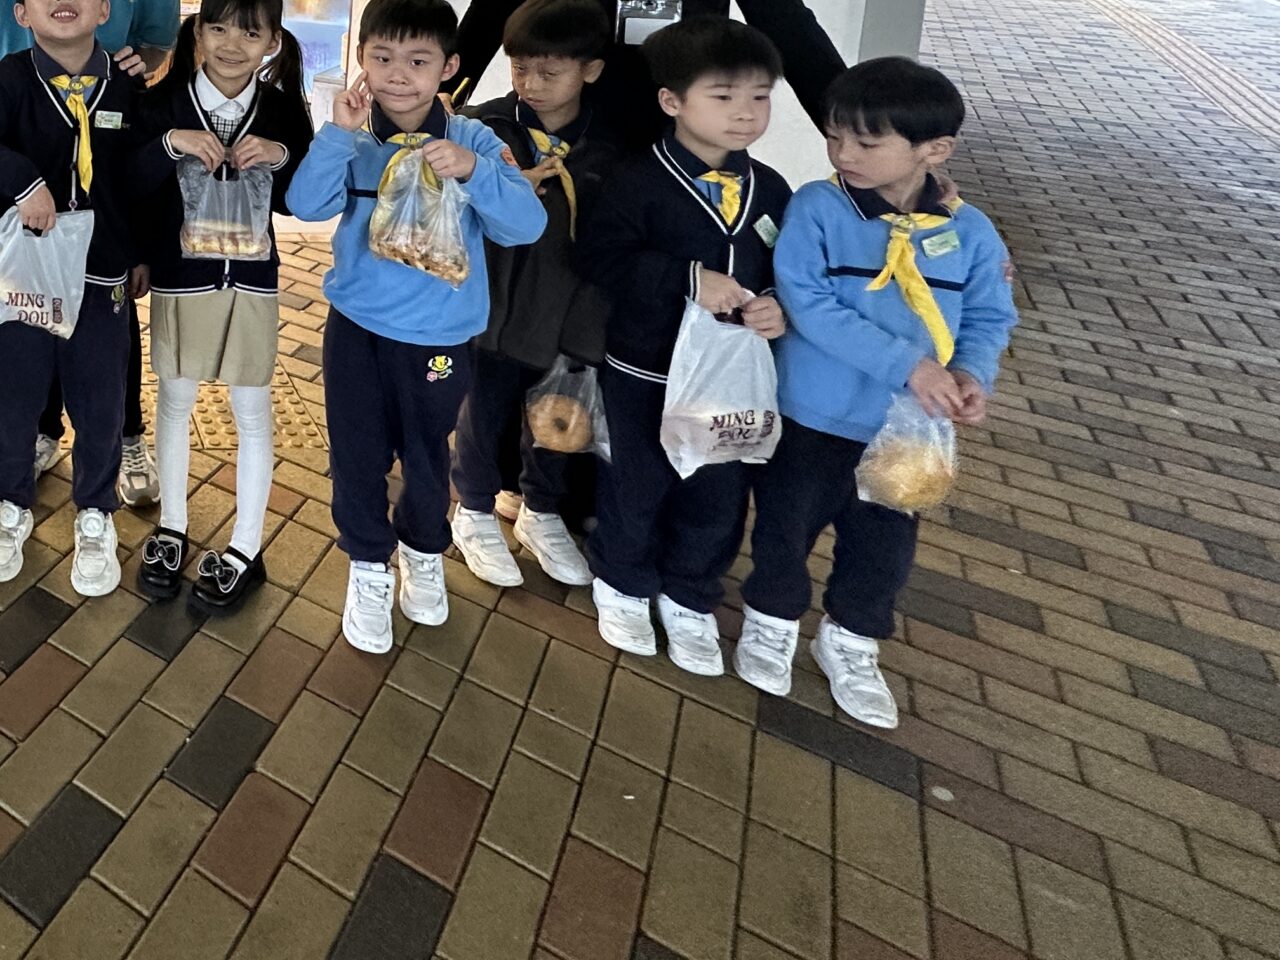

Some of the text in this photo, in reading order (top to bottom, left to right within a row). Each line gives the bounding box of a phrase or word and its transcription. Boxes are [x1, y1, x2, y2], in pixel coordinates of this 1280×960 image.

[5, 291, 45, 308] MING
[17, 309, 49, 326] DOU
[709, 409, 756, 432] MING
